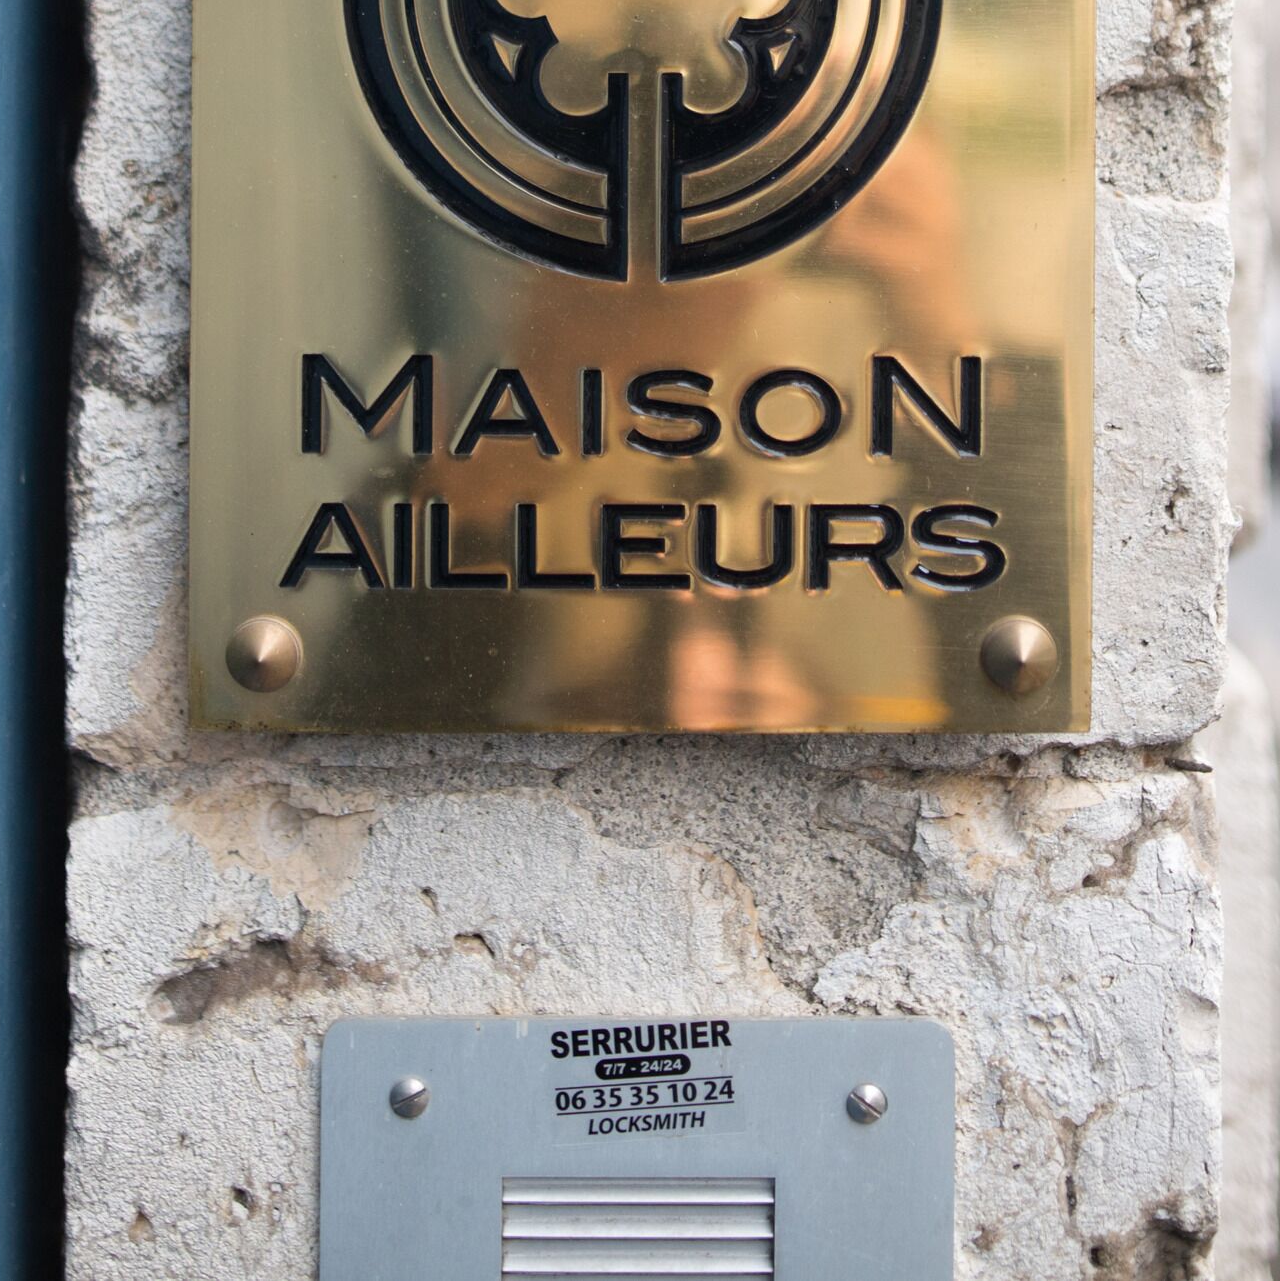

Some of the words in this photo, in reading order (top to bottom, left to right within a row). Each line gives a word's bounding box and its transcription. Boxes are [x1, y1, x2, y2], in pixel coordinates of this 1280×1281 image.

[301, 353, 983, 458] MAISON
[279, 502, 1008, 591] AILLEURS
[551, 1020, 732, 1058] SERRURIER
[603, 1063, 626, 1076] 7/7
[640, 1058, 682, 1073] 24/24
[555, 1090, 586, 1111] 06
[593, 1087, 622, 1109] 35
[630, 1084, 659, 1106] 35
[667, 1082, 697, 1103] 10
[704, 1079, 735, 1101] 24
[588, 1111, 705, 1135] LOCKSMITH
